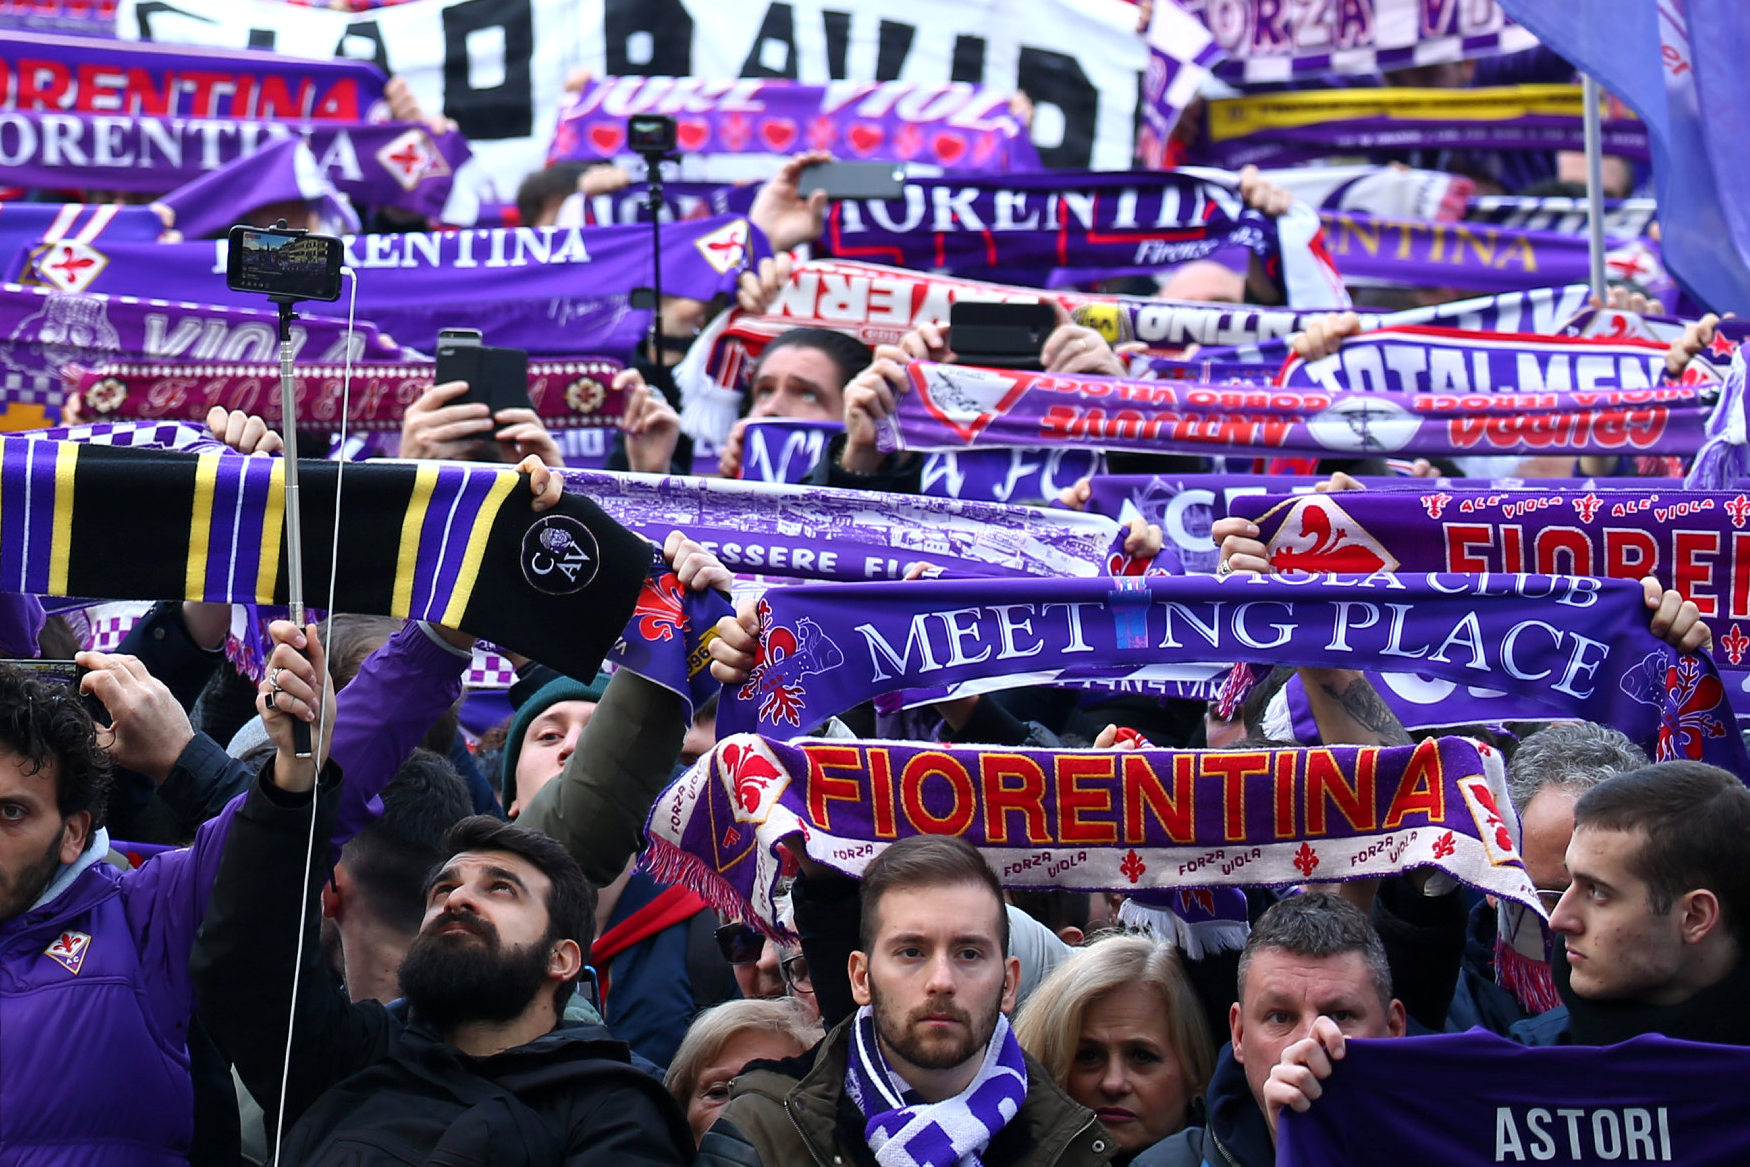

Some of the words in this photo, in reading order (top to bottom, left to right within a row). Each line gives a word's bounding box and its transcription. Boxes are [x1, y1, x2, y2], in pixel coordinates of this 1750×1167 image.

[1501, 496, 1564, 519] VIOLA
[1653, 497, 1716, 523] VIOLA
[1426, 571, 1603, 608] CLUB
[1325, 600, 1611, 701] PLACE
[802, 736, 1446, 845] FIORENTINA
[833, 843, 874, 861] FORZA
[1003, 851, 1052, 879] FORZA
[1047, 850, 1088, 879] VIOLA
[1178, 849, 1225, 877] FORZA
[1221, 847, 1262, 876] VIOLA
[1350, 835, 1394, 868] FORZA
[1389, 830, 1419, 863] VIOLA
[1494, 1106, 1673, 1163] ASTORI
